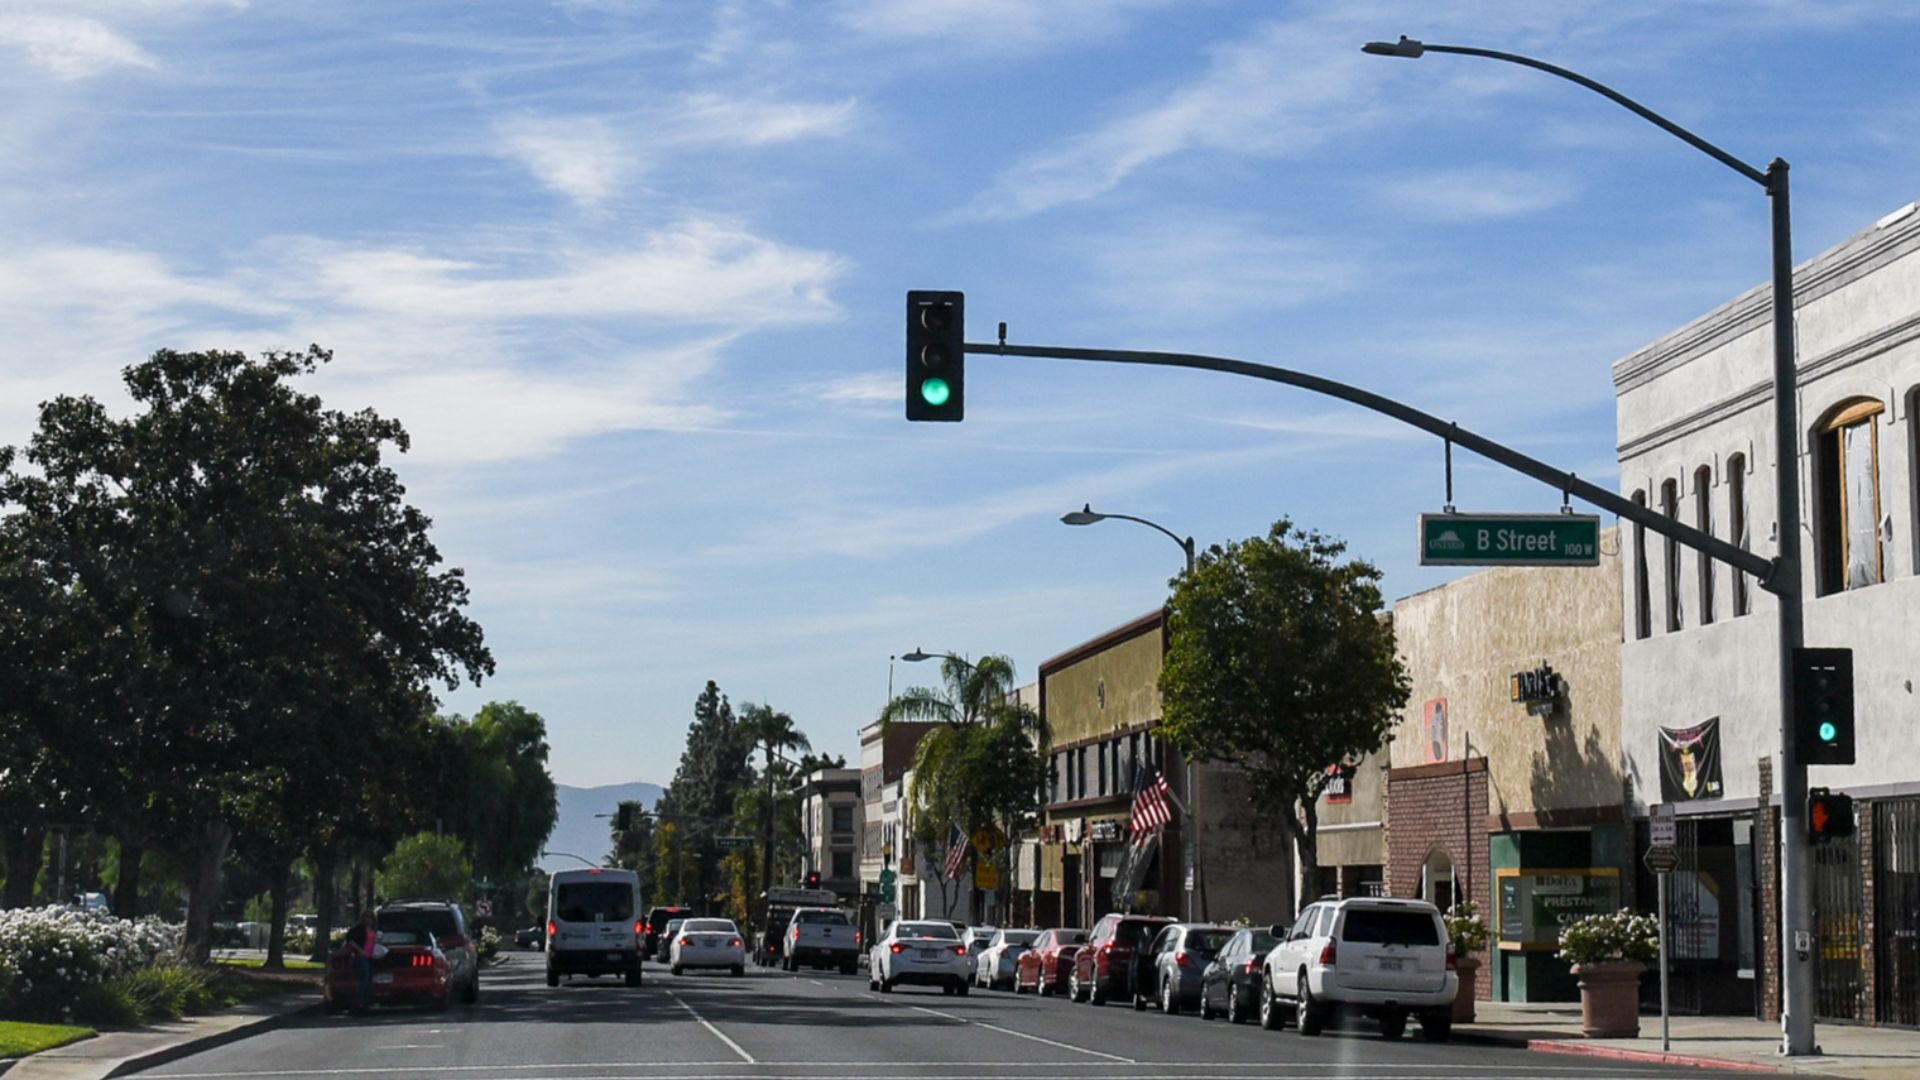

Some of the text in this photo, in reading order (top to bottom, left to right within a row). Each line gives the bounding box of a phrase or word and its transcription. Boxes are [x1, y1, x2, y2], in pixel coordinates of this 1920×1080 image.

[1478, 529, 1556, 551] B Street
[1565, 544, 1593, 555] 100 W
